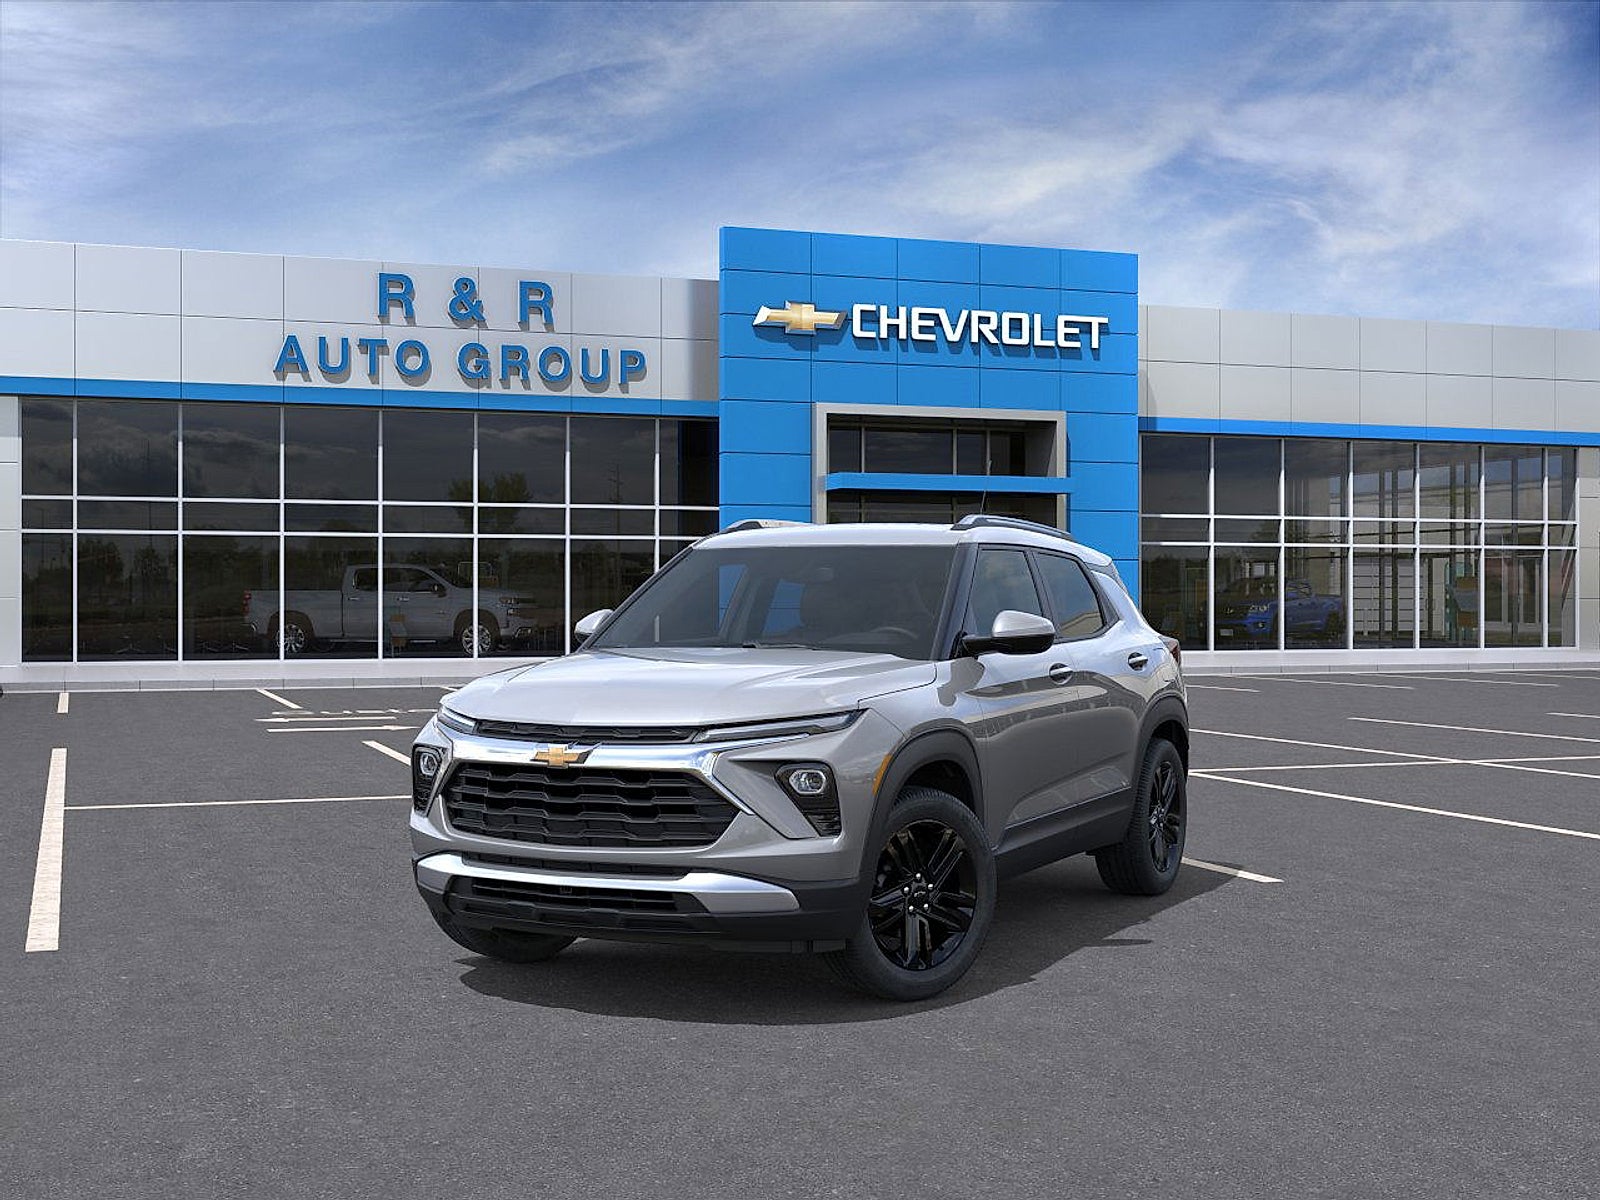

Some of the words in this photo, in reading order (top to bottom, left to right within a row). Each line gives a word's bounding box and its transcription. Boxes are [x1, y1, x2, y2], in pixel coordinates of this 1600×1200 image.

[378, 272, 415, 319] R
[449, 277, 486, 323] &
[518, 280, 554, 326] R
[852, 303, 1109, 349] CHEVROLET
[274, 334, 431, 378] AUTO
[457, 342, 646, 386] GROUP
